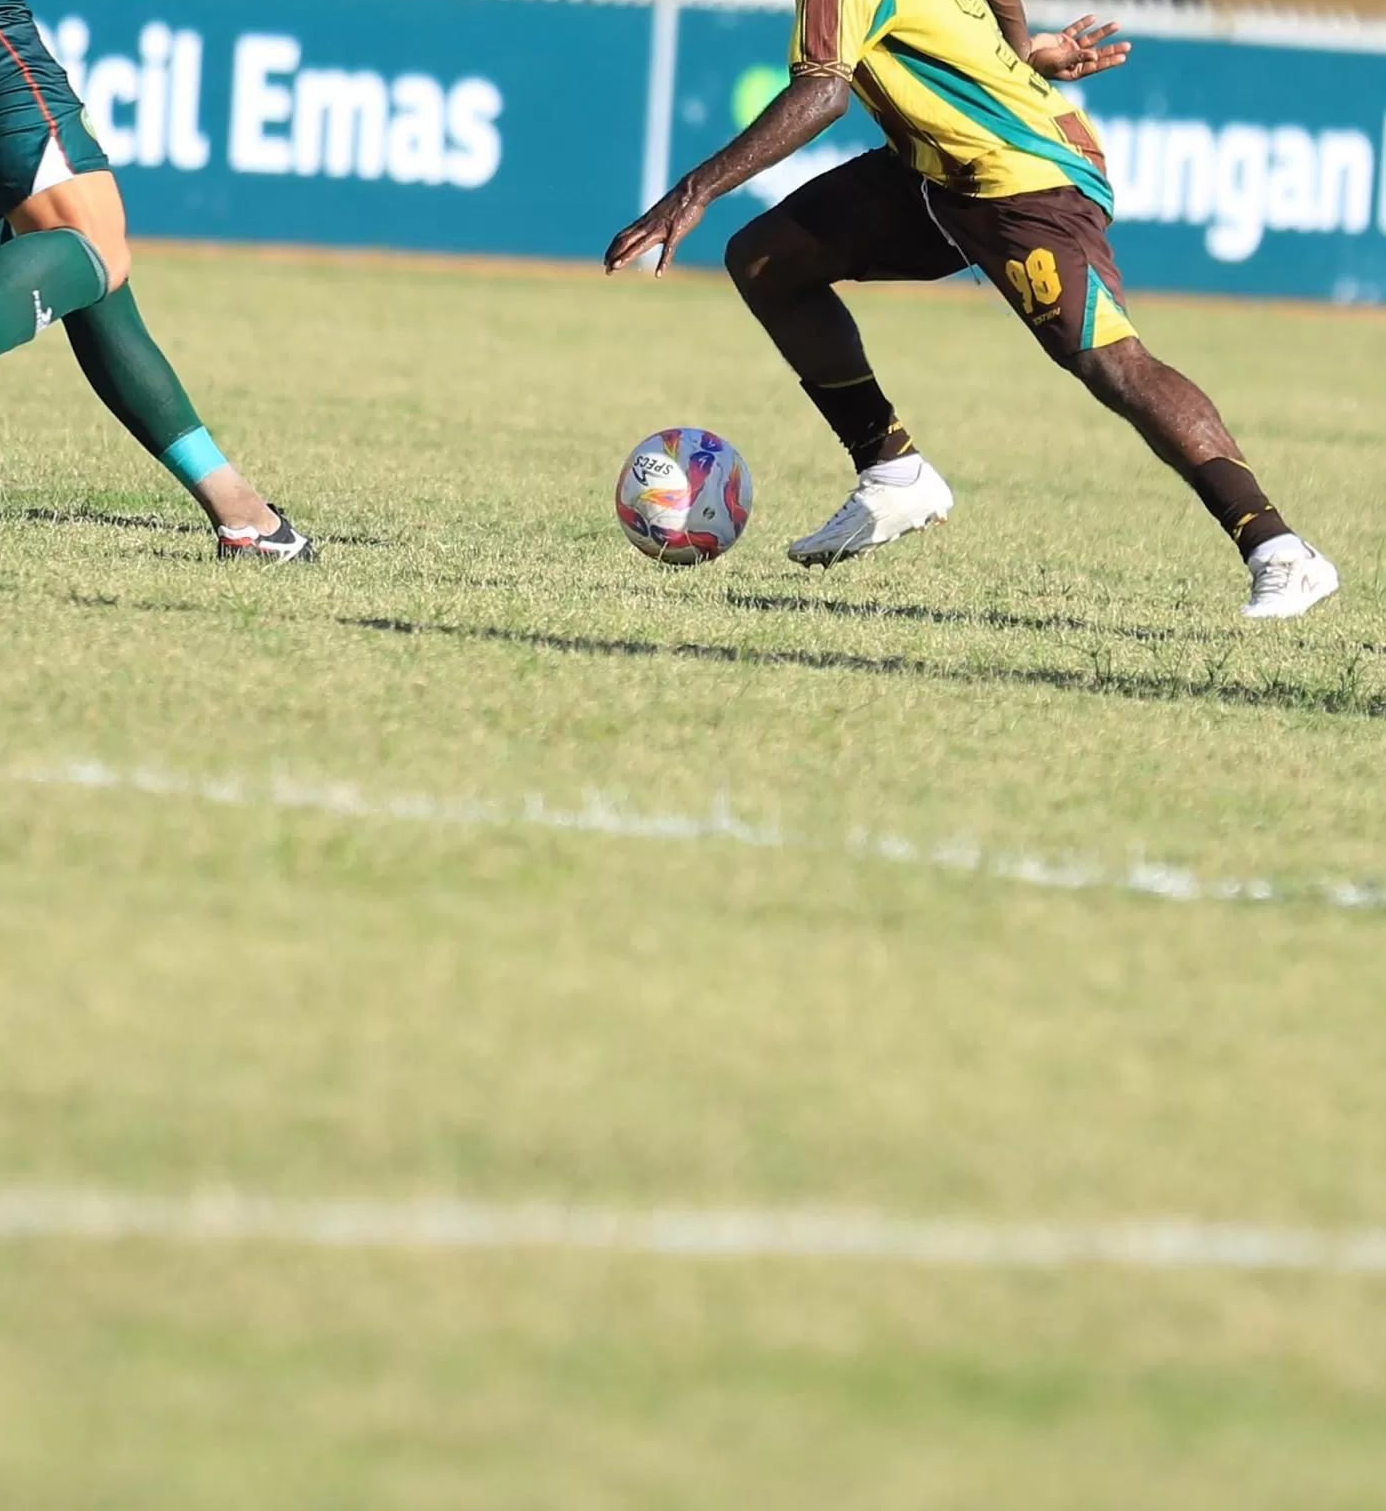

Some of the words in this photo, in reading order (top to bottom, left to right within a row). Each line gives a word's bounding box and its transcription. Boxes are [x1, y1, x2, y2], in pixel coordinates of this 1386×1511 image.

[34, 16, 211, 171] icil
[227, 31, 505, 190] Emas
[1091, 111, 1374, 263] ungan
[1005, 247, 1063, 314] 98
[633, 455, 674, 475] SPECS
